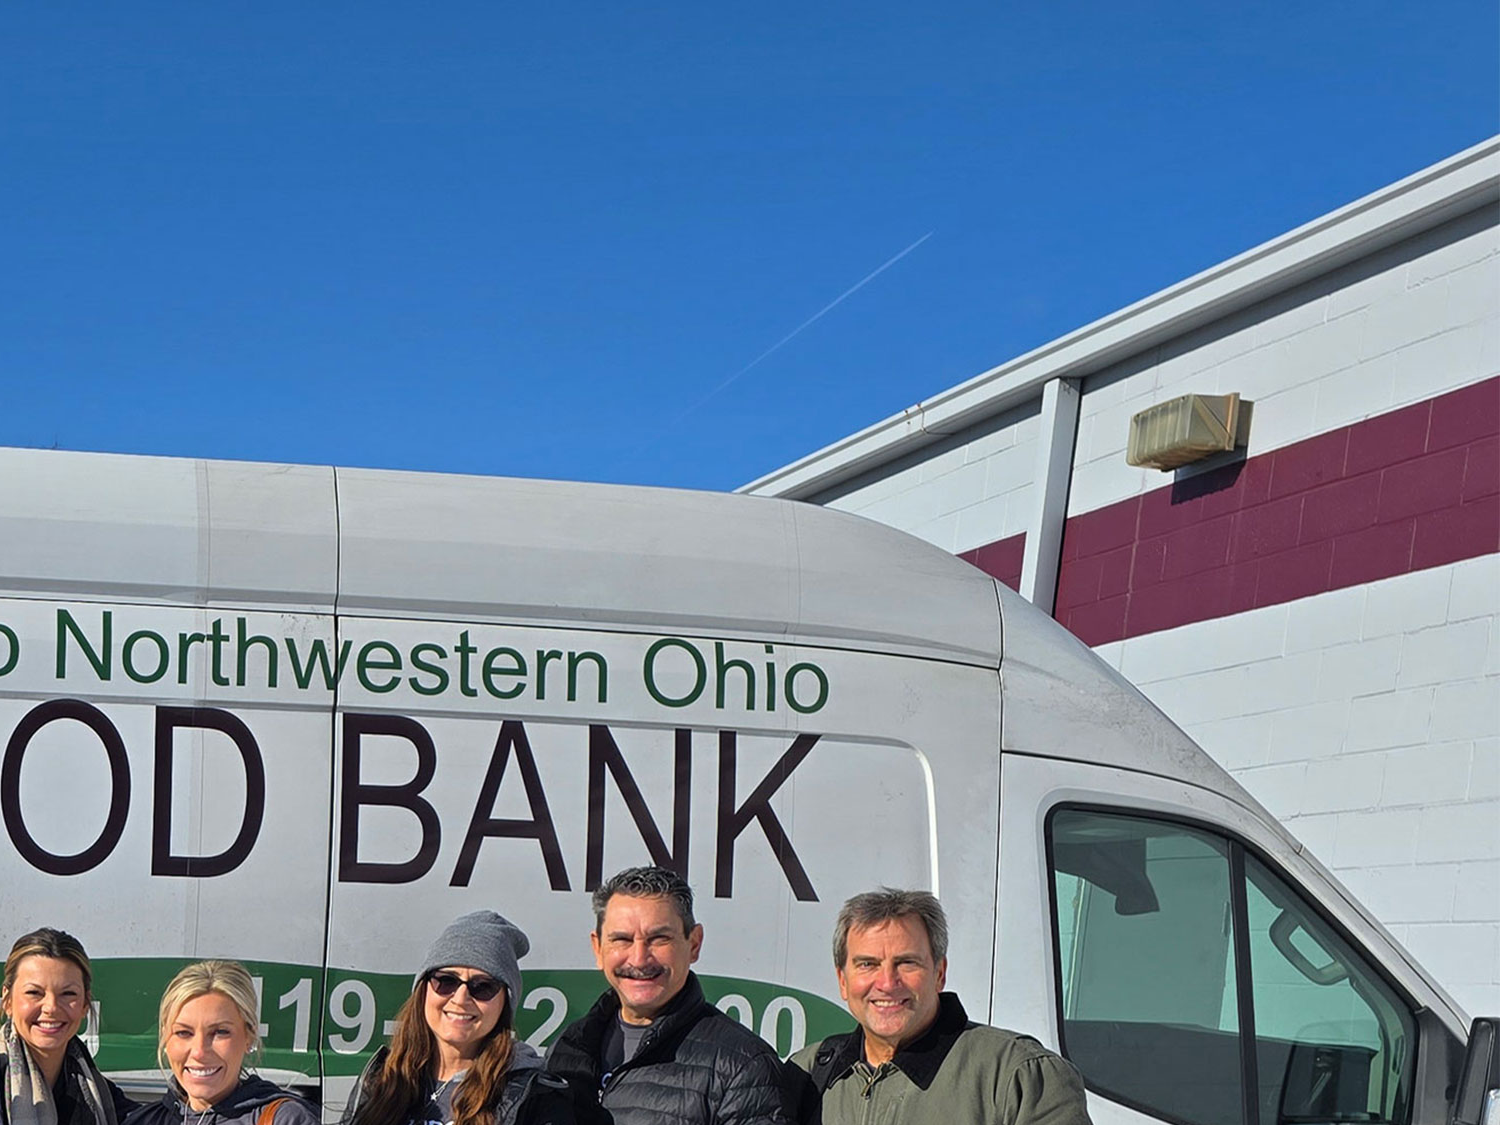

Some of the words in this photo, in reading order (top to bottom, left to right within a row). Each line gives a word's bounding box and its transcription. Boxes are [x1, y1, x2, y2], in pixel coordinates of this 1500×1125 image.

[55, 608, 608, 703] Northwestern
[643, 638, 829, 714] Ohio
[338, 712, 823, 902] BANK
